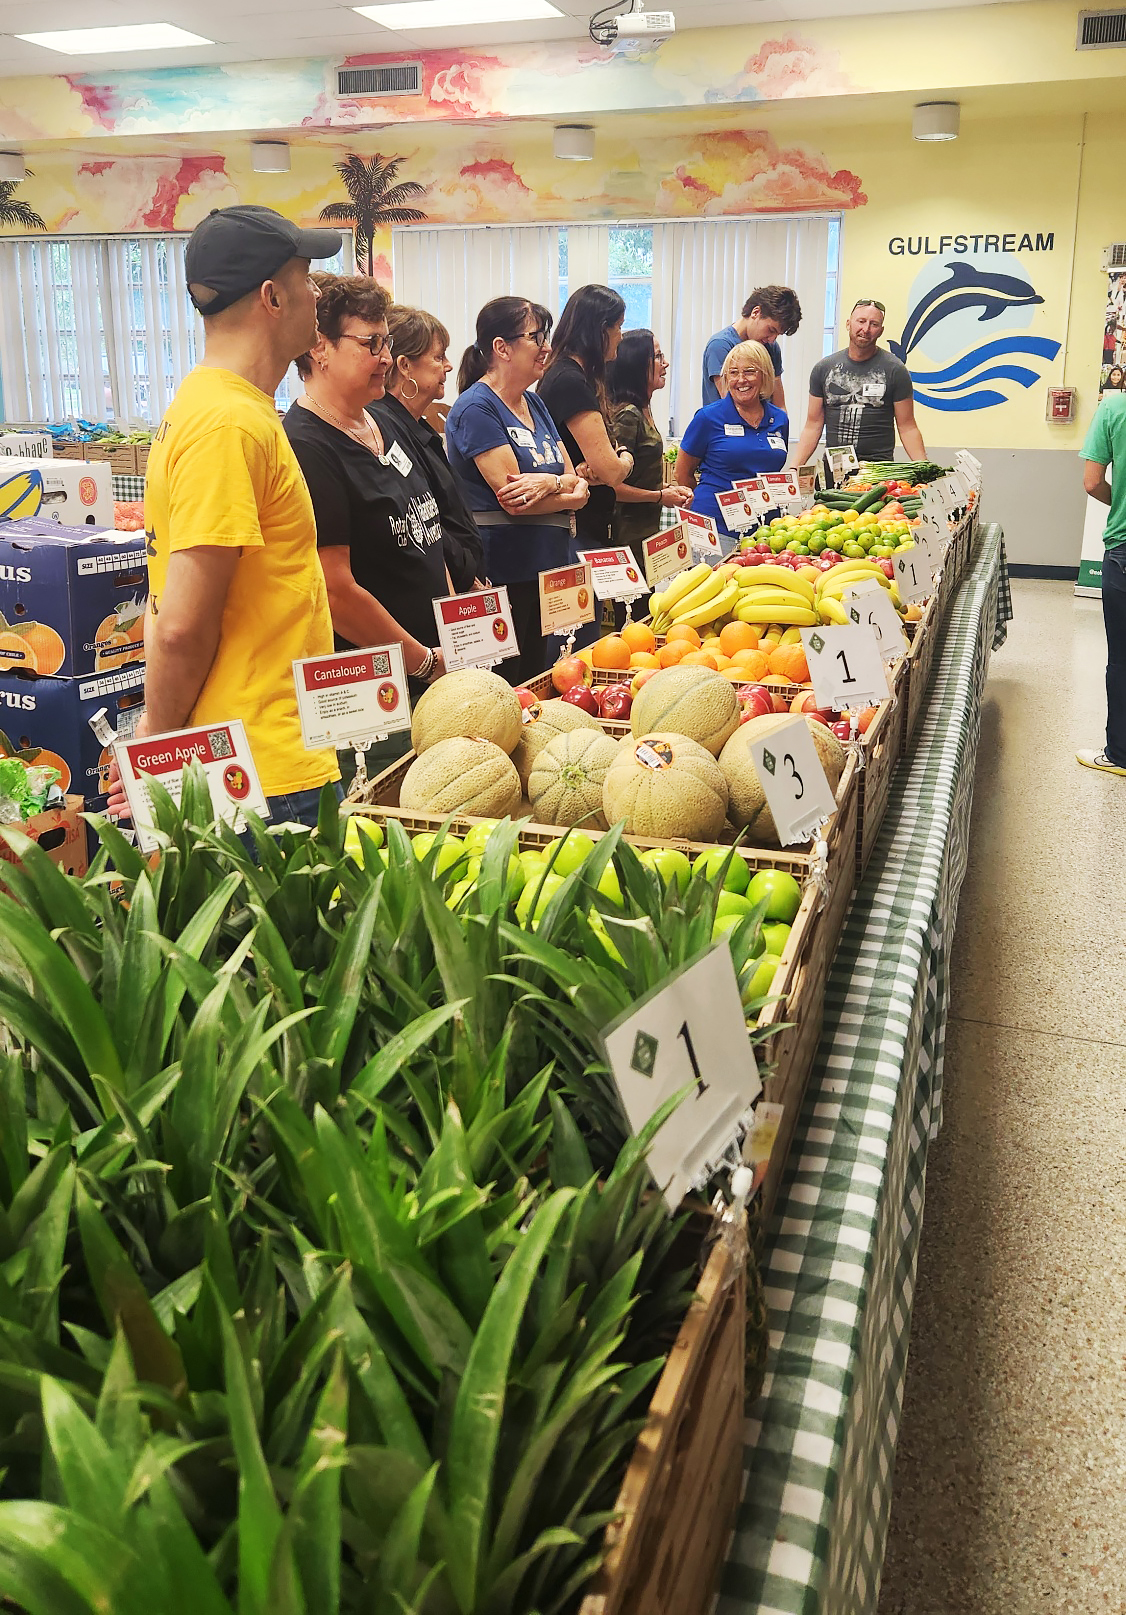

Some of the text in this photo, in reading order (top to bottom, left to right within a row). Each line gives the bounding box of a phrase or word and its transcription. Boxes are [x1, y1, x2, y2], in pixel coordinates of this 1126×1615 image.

[888, 232, 1055, 256] GULFSTREAM
[949, 484, 957, 497] 4
[593, 556, 615, 564] Bananas
[549, 578, 567, 588] Orange
[910, 562, 918, 587] 1
[458, 604, 478, 616] Apple
[868, 611, 883, 641] 6
[83, 640, 112, 652] Oranges
[314, 664, 367, 681] Cantaloupe
[836, 650, 857, 684] 1
[137, 743, 207, 768] Green Apple
[784, 753, 804, 800] 3
[677, 1020, 710, 1100] 1
